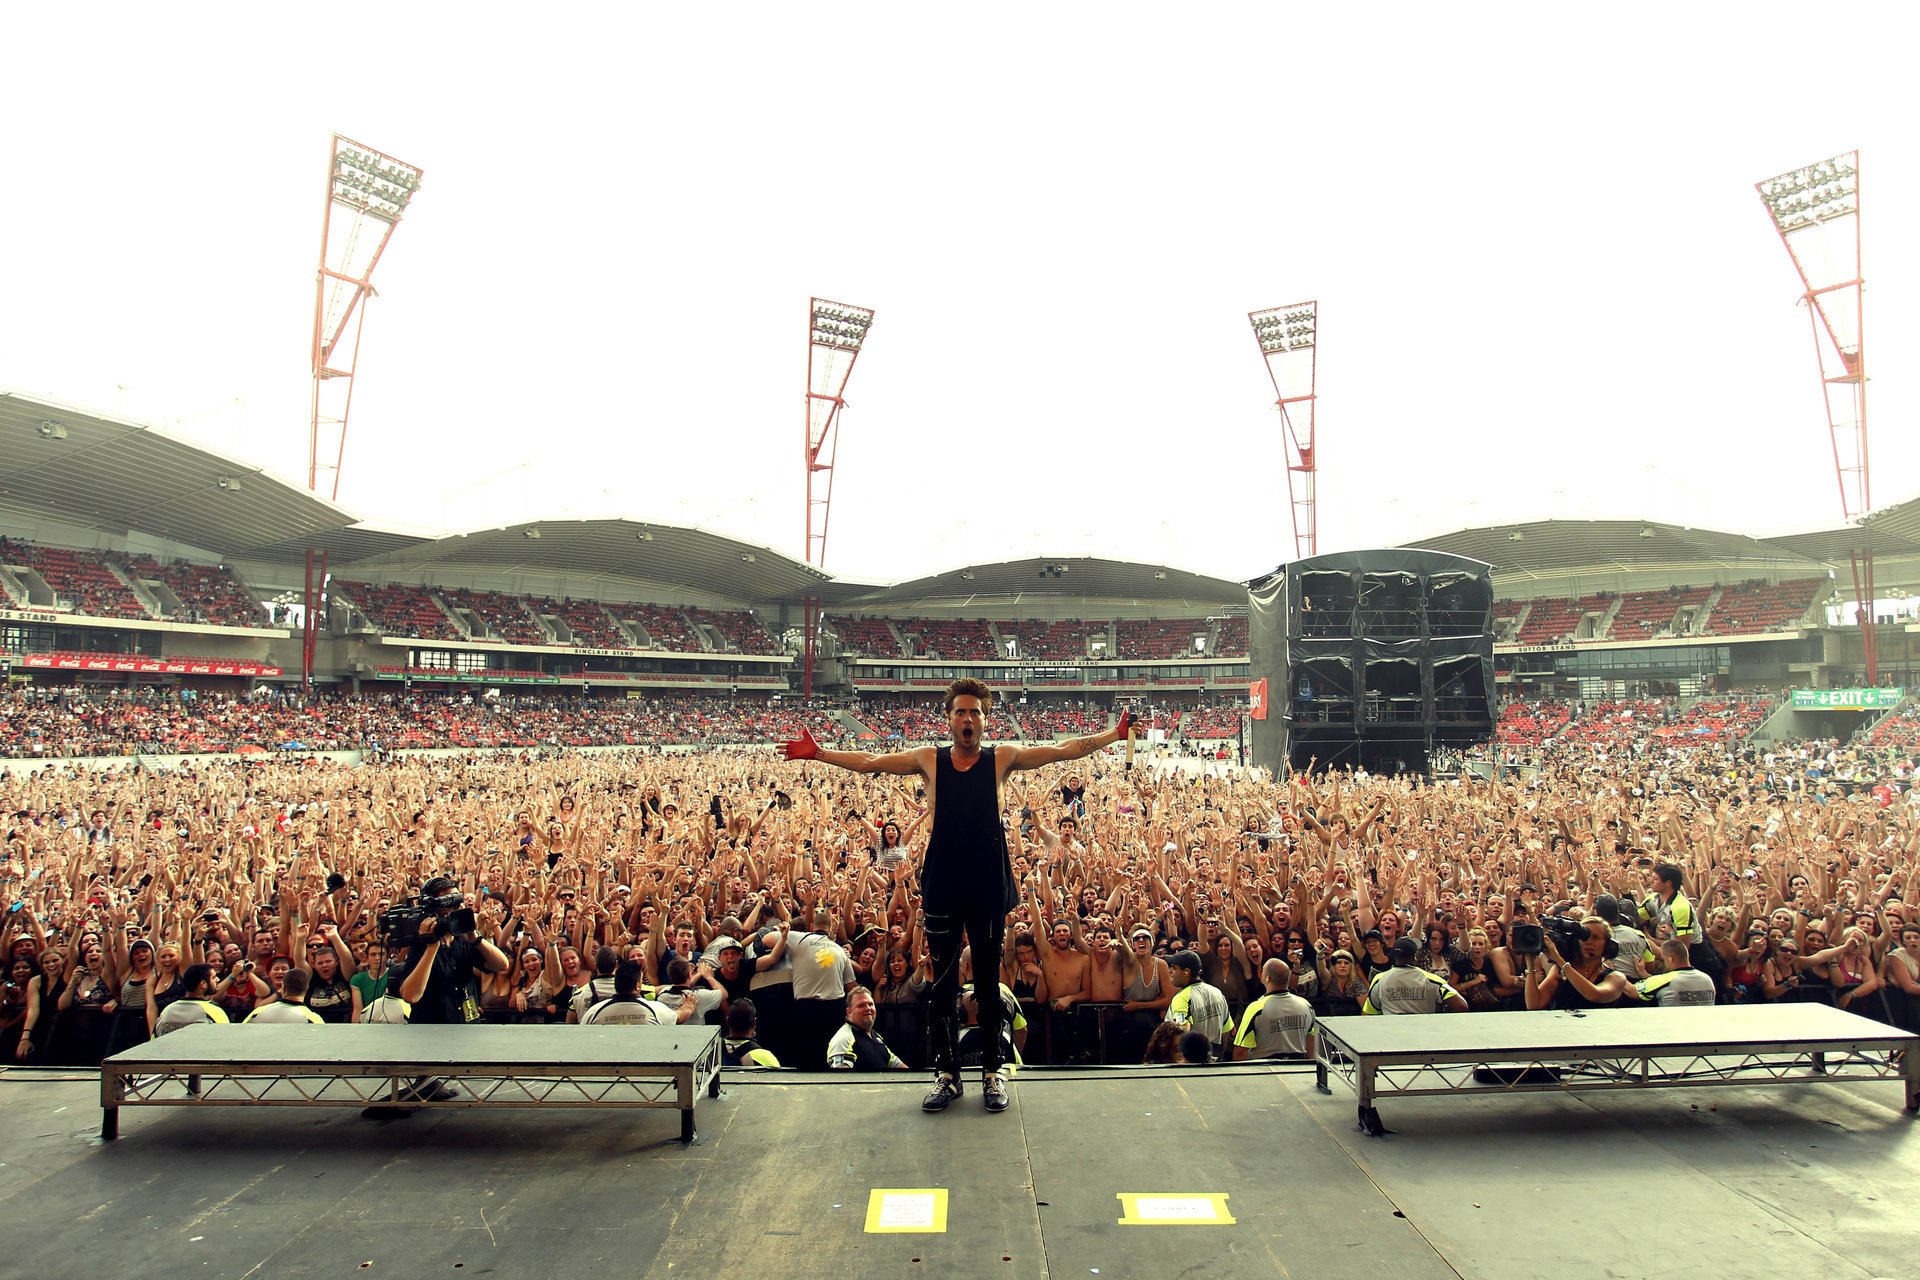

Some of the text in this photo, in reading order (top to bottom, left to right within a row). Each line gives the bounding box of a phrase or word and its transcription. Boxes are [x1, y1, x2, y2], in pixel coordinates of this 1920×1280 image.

[19, 612, 57, 622] STAND
[1829, 691, 1864, 705] EXIT
[1386, 986, 1426, 1001] SECURITY
[604, 1014, 626, 1022] EVENT
[1270, 1014, 1308, 1031] SECURITY
